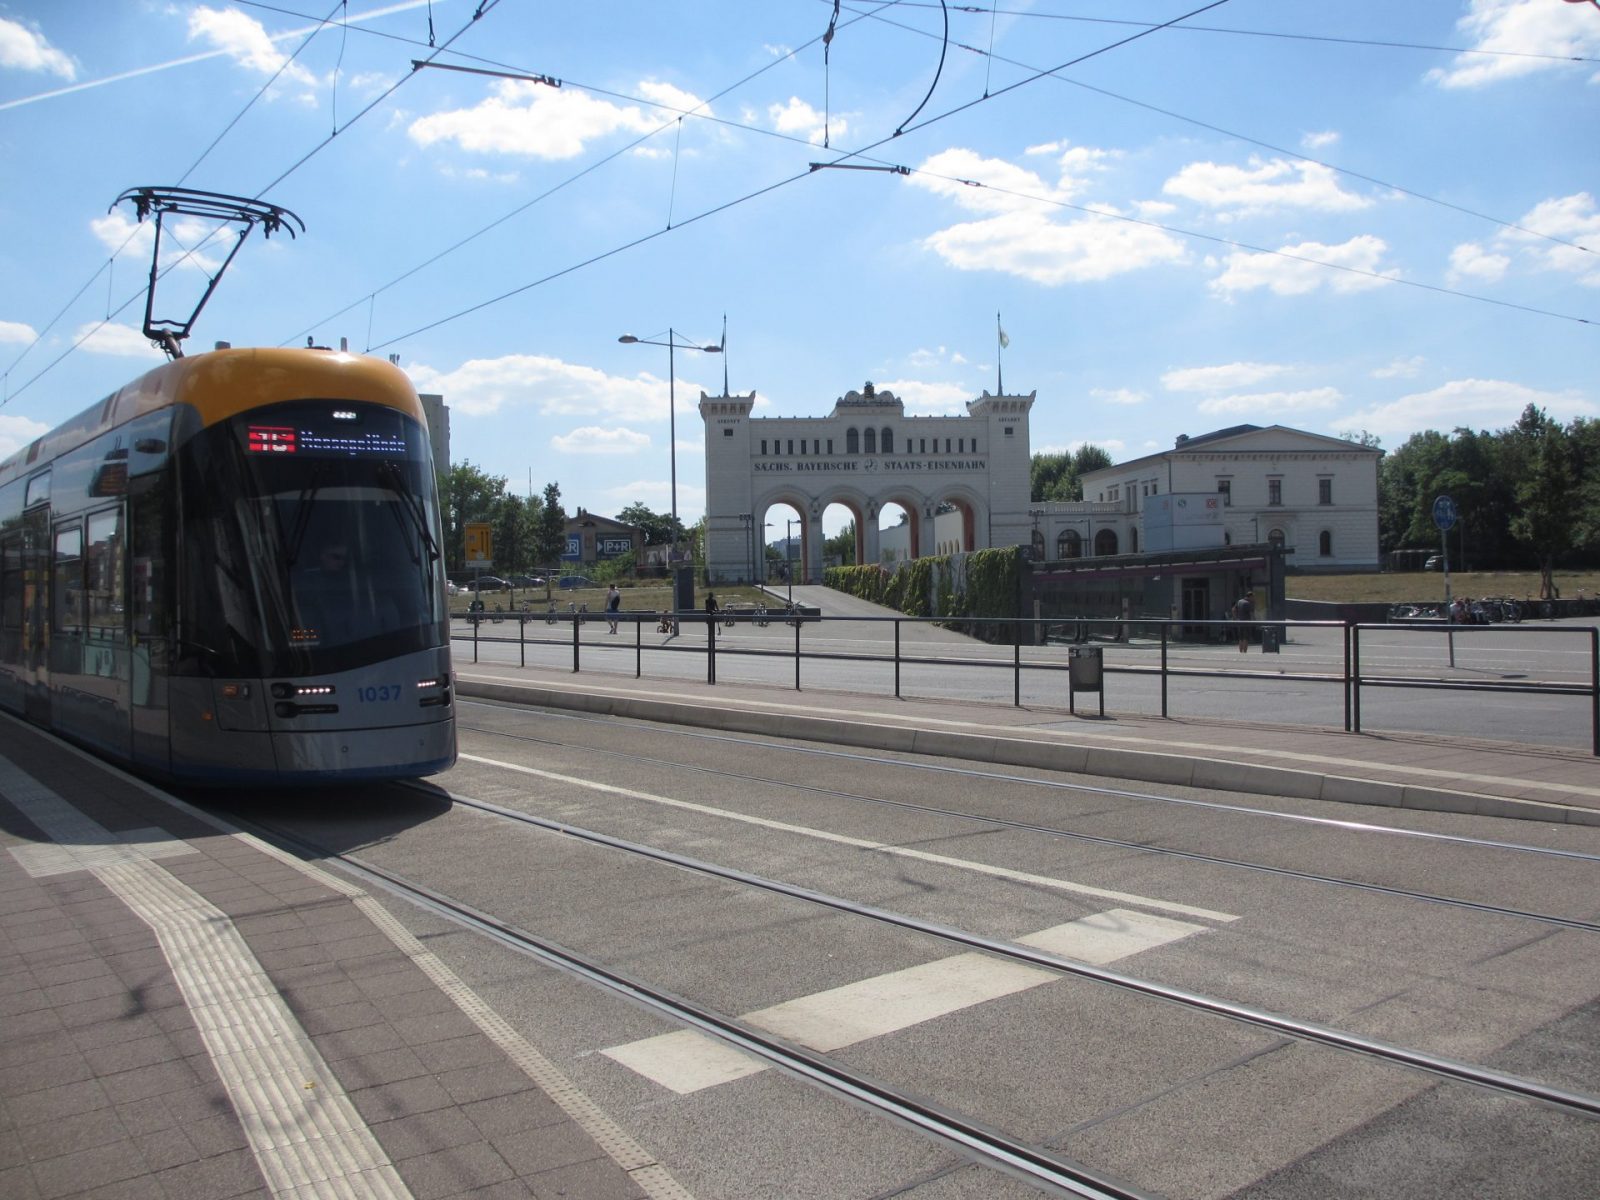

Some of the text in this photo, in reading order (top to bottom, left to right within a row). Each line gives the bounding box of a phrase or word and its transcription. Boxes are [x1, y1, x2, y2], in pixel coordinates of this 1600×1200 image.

[797, 461, 859, 471] BAYERSCHE
[884, 460, 986, 470] STAATS-EISENBAHN
[606, 541, 629, 552] P+R
[358, 684, 402, 703] 1037
